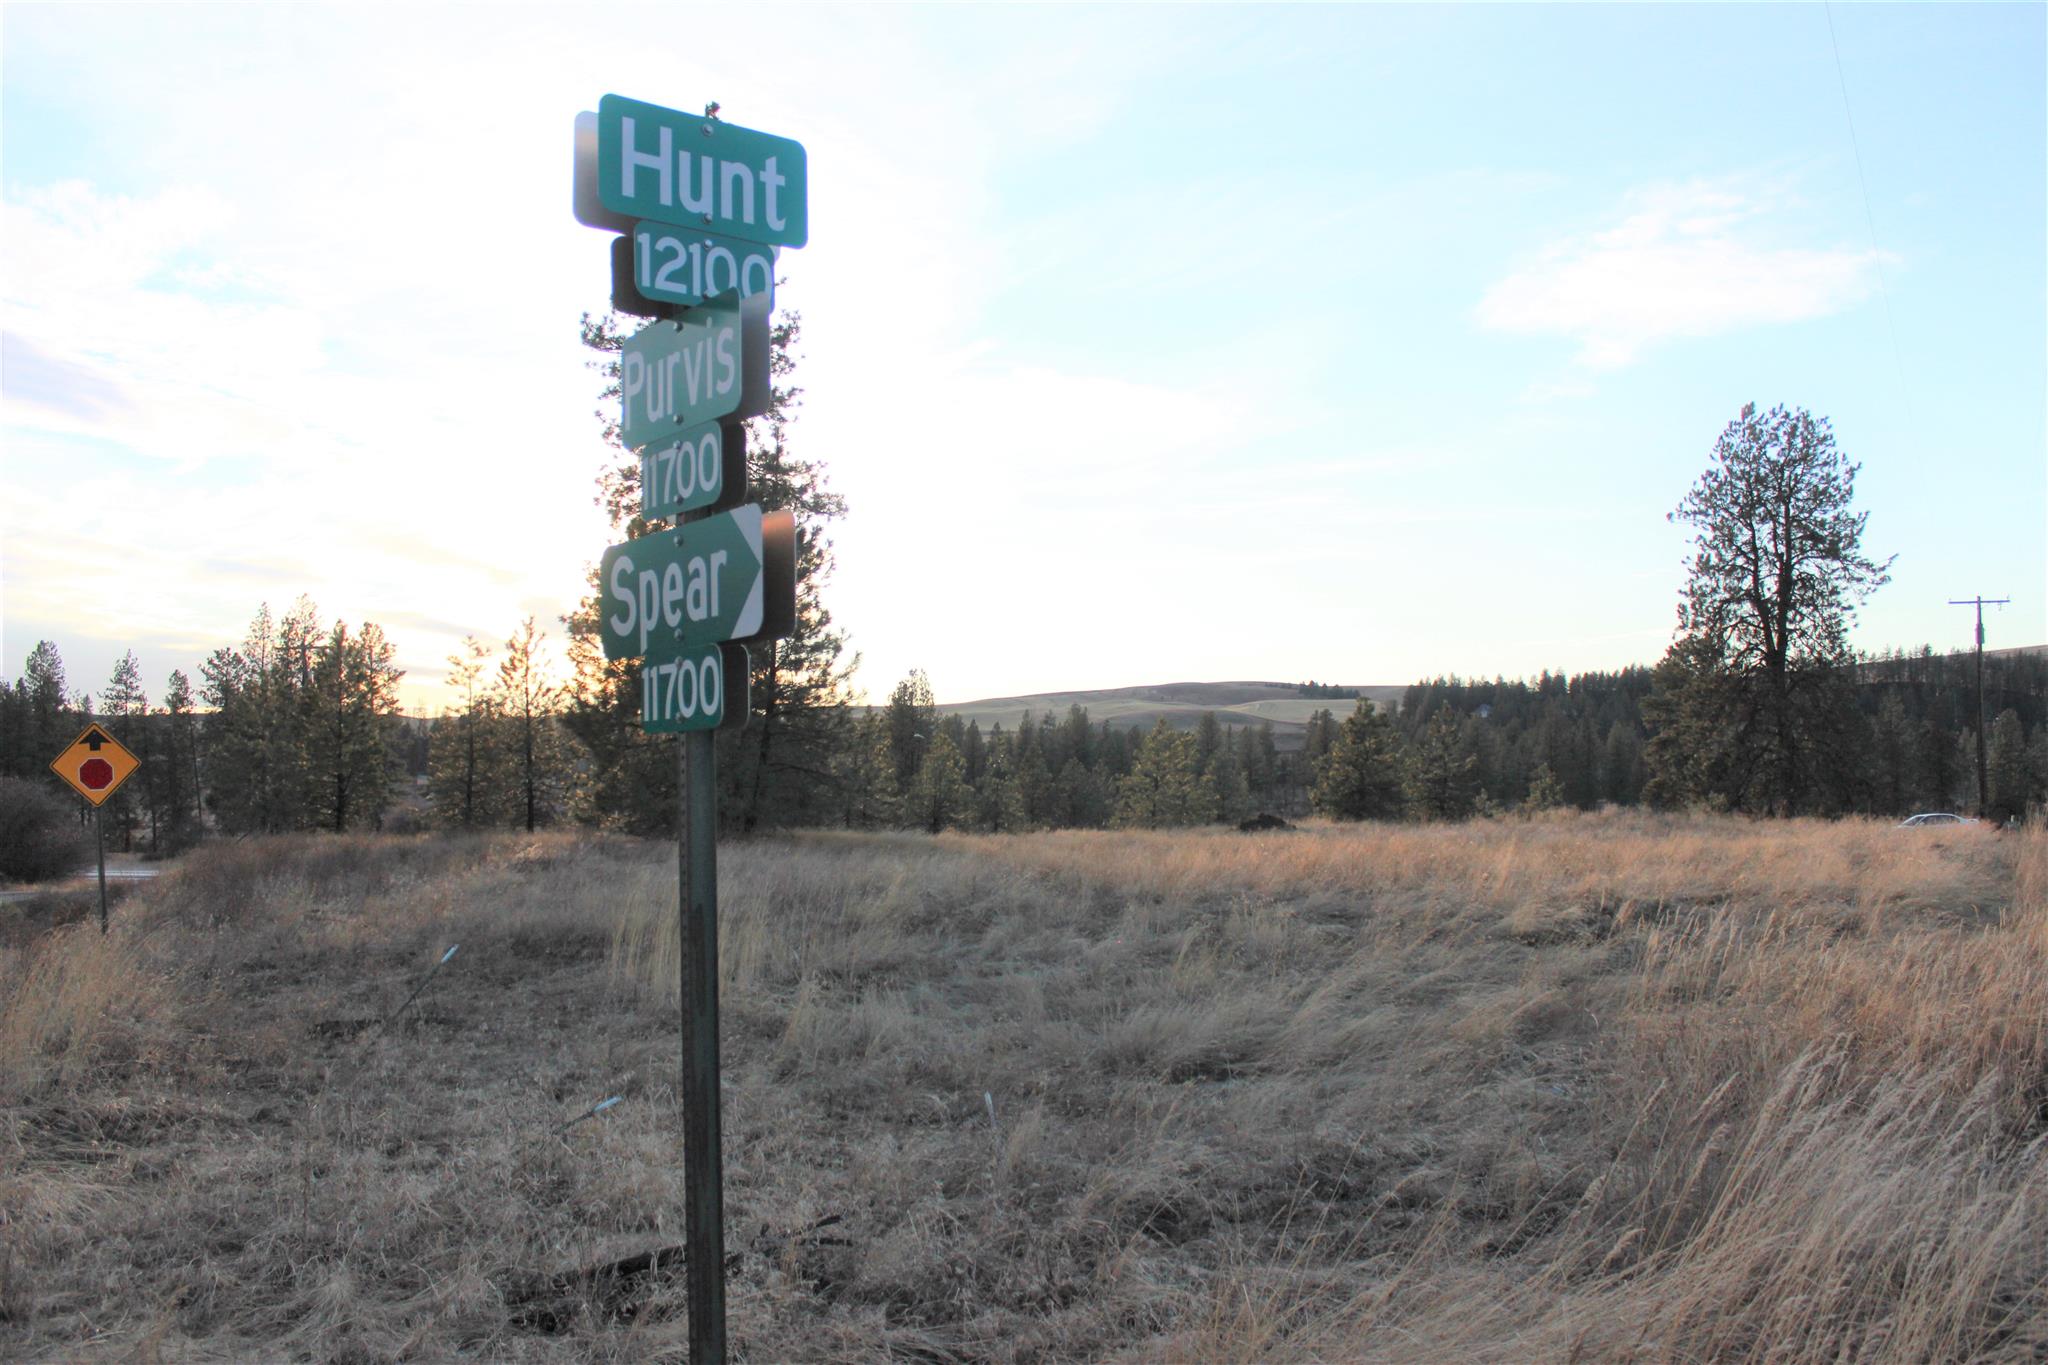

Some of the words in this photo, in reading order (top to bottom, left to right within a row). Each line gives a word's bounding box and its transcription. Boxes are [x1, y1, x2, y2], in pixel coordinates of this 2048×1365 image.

[621, 116, 785, 232] Hunt
[637, 232, 772, 298] 12100
[625, 316, 735, 431] Purvis
[642, 432, 720, 510] 11700
[610, 550, 727, 654] Spear
[642, 655, 720, 722] 11700
